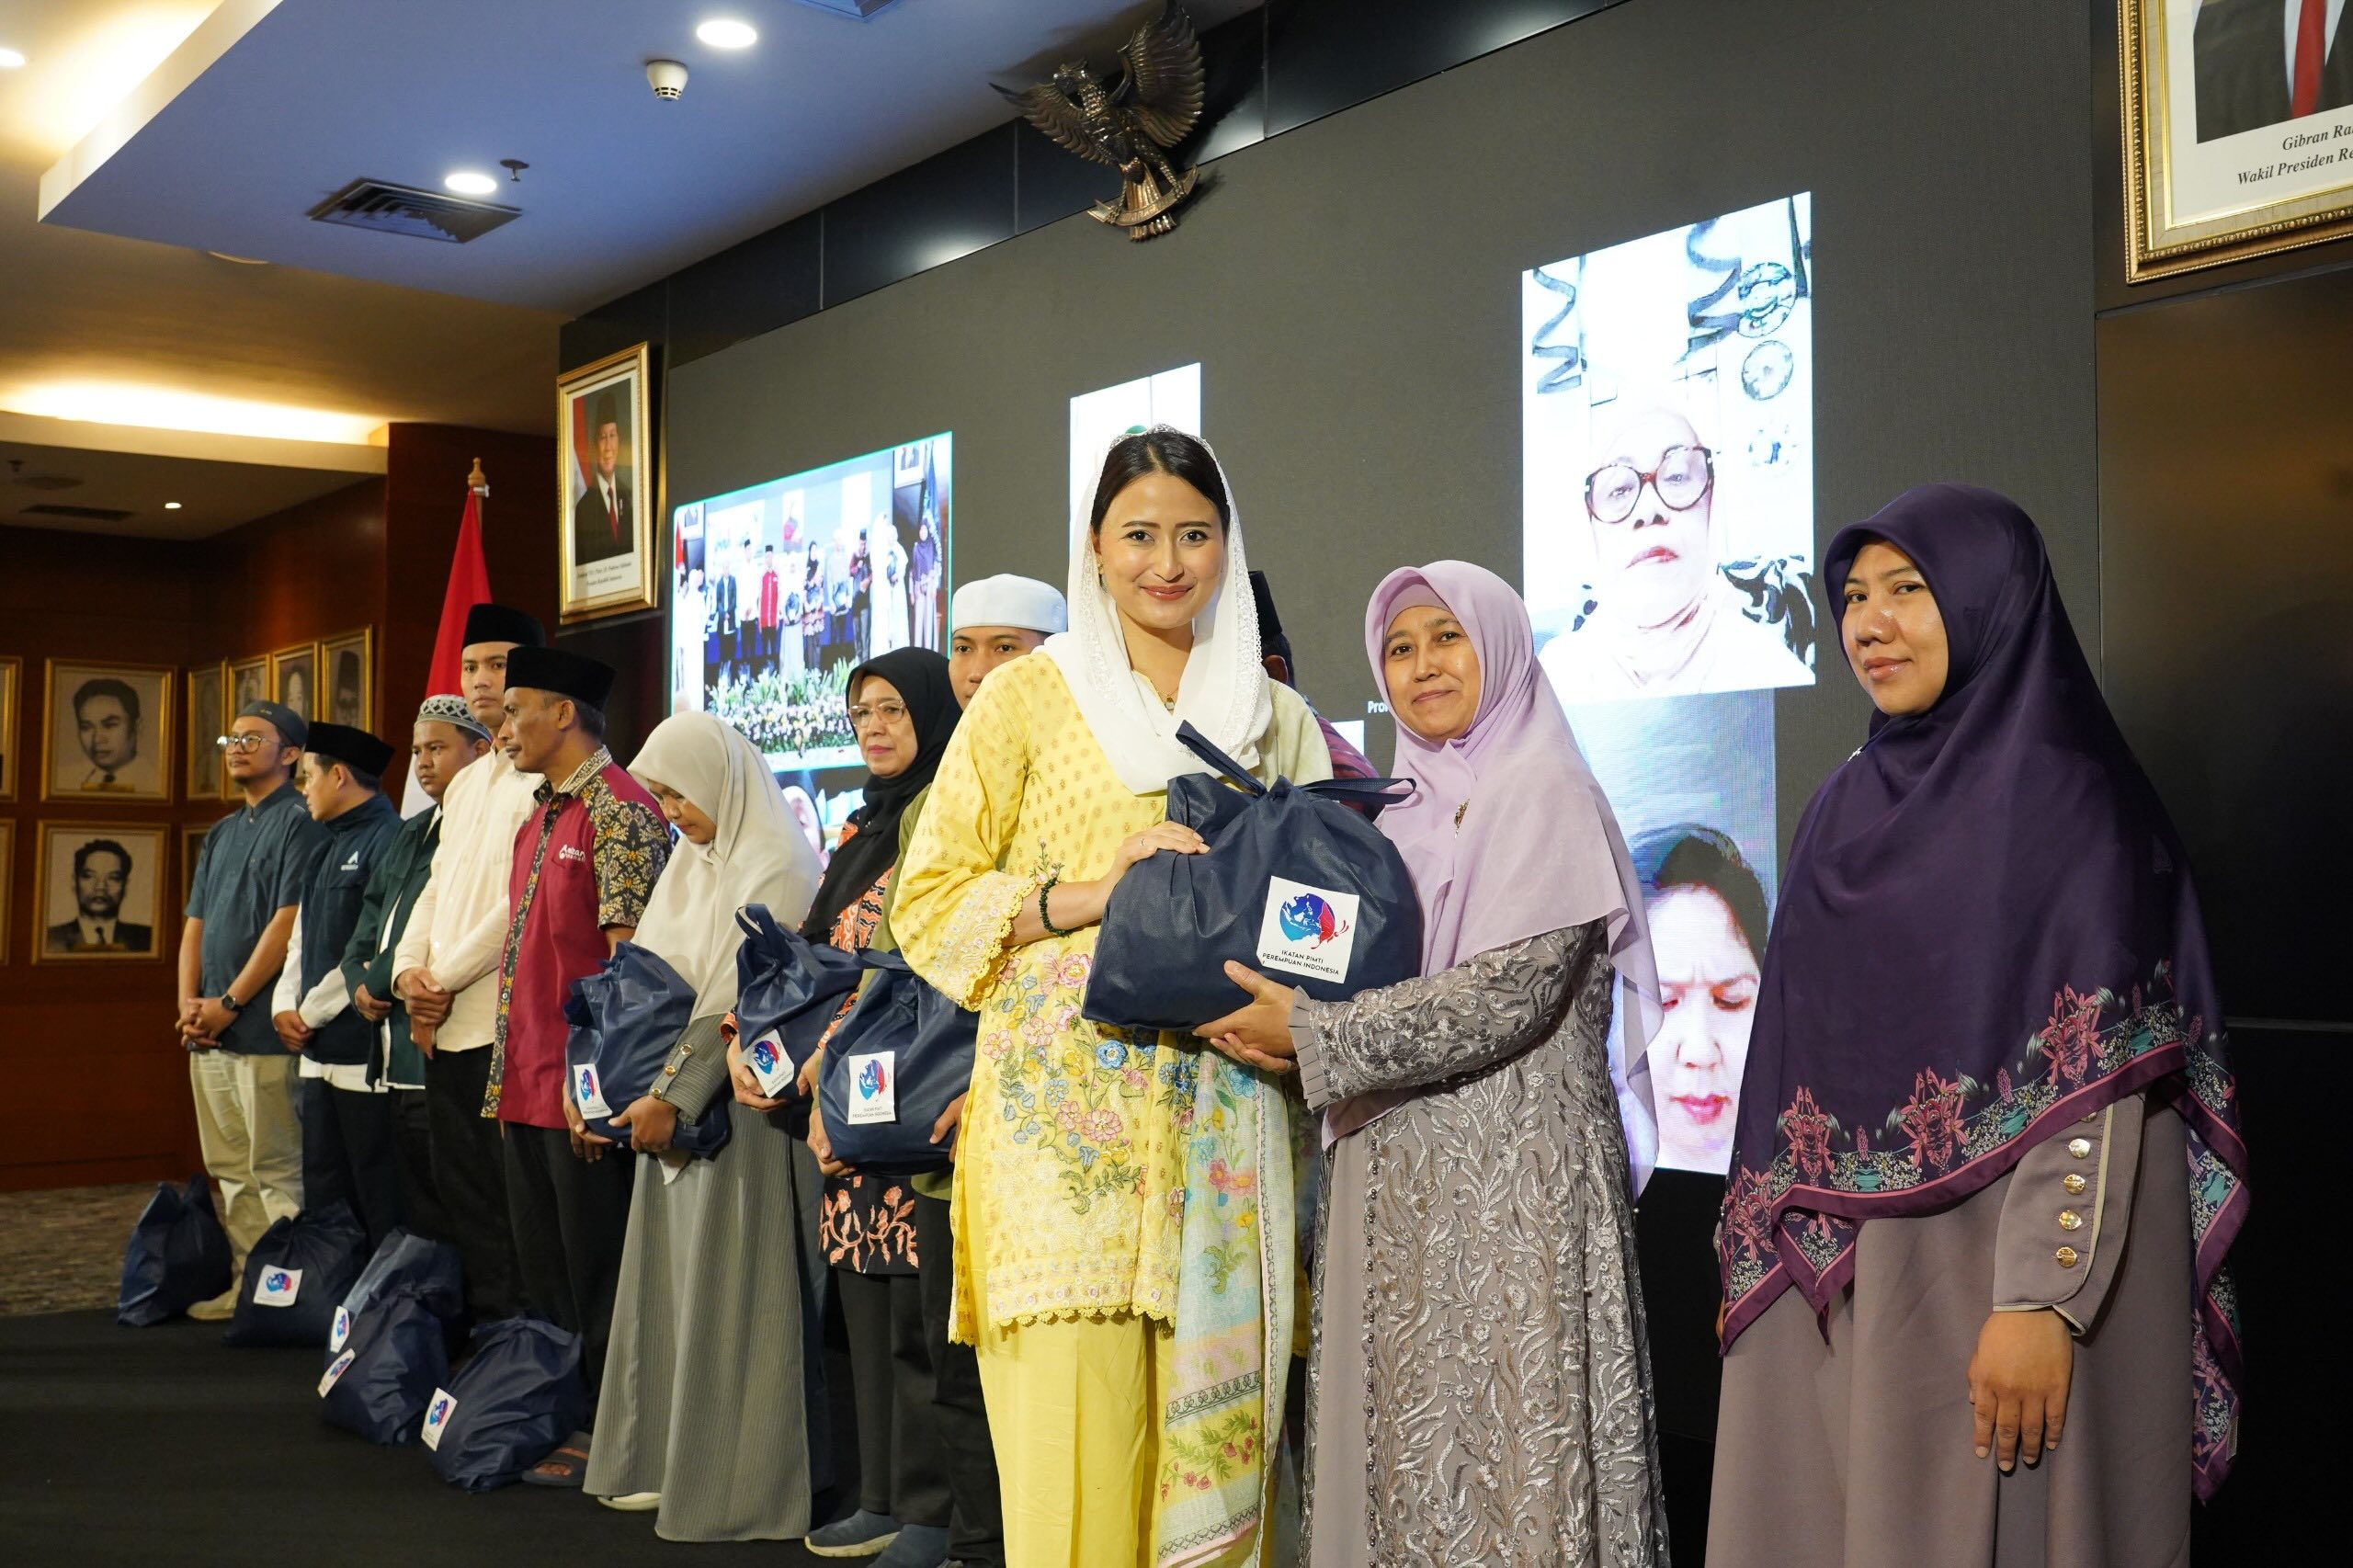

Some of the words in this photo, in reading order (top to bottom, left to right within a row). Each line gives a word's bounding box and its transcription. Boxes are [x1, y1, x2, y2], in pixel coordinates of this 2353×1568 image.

[2282, 131, 2328, 151] Gibran
[2333, 124, 2353, 139] Ra
[2237, 165, 2274, 185] Wakil
[2277, 154, 2334, 176] Presiden
[1262, 953, 1302, 966] PEREMPUAN
[1303, 963, 1339, 975] INDONESIA
[1281, 950, 1304, 959] IKATAN
